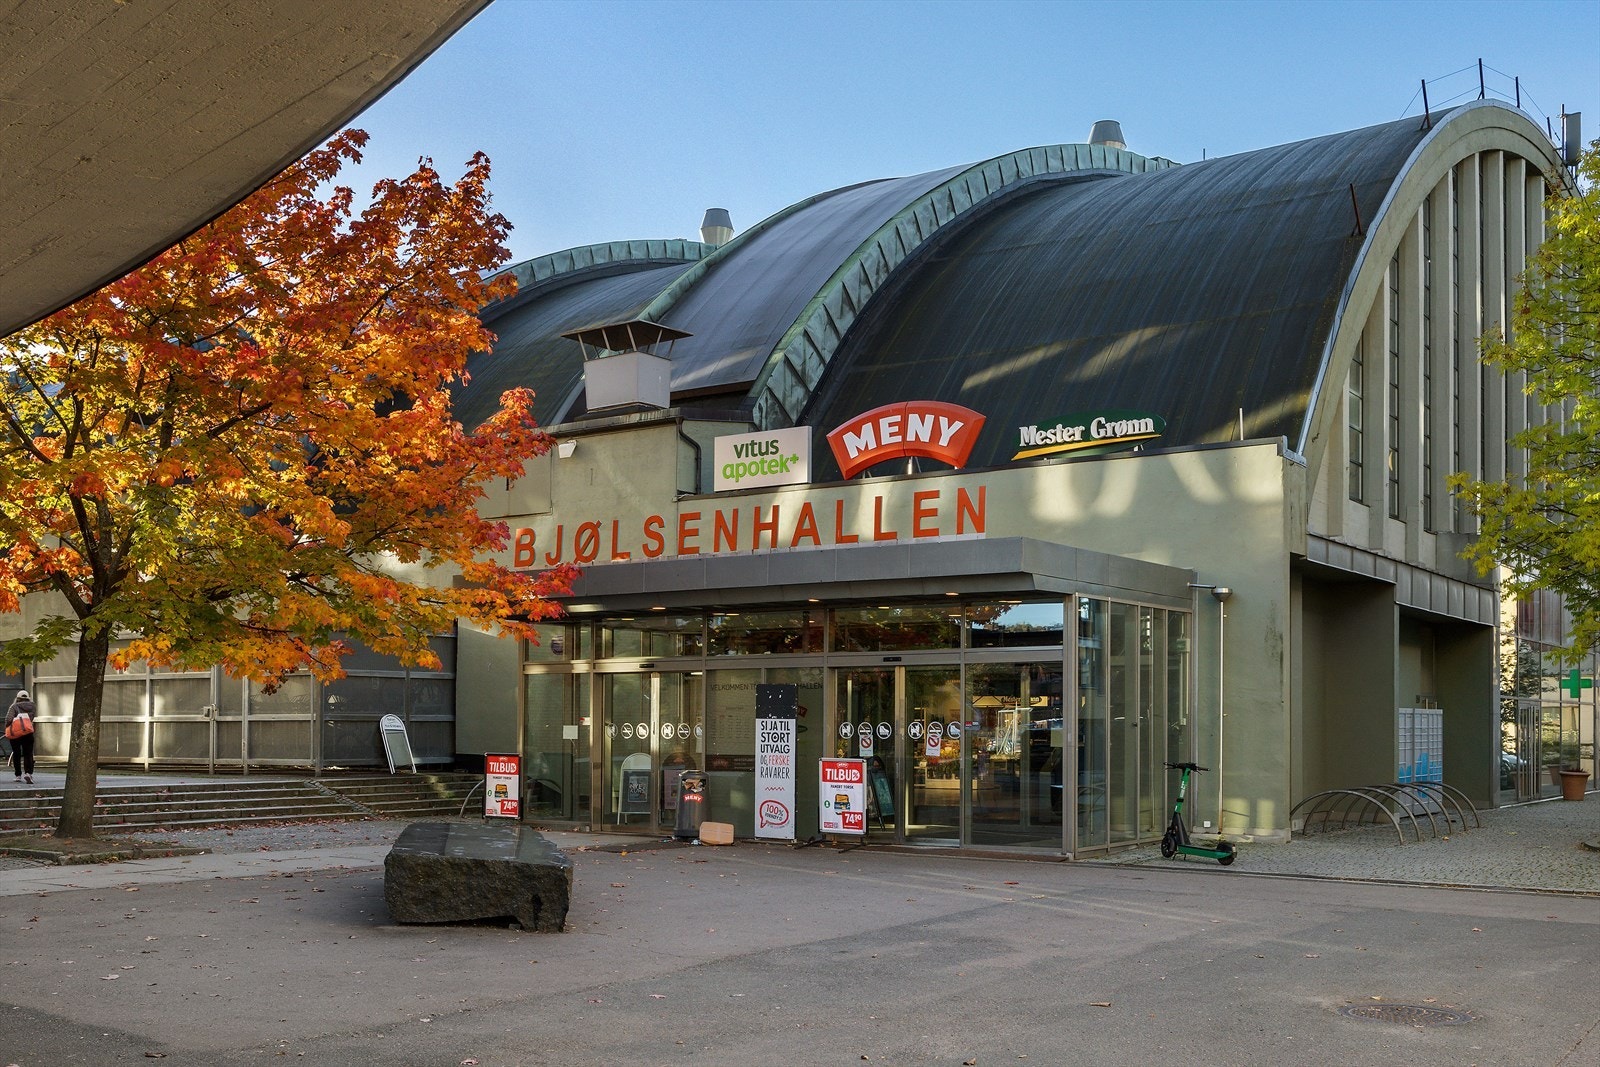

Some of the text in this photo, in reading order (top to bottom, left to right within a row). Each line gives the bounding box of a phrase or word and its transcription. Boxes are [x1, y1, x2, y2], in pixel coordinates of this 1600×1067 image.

[842, 413, 964, 459] MENY
[1019, 416, 1155, 447] Mester Grønn
[733, 438, 779, 459] vitus
[514, 485, 987, 568] BJØLSENHALLEN
[760, 721, 790, 731] SI JA TIL
[760, 744, 791, 754] UTVALG
[768, 755, 790, 766] FERSKE
[489, 762, 516, 773] TILBUD
[825, 768, 861, 780] TILBUD
[766, 804, 784, 816] 100%
